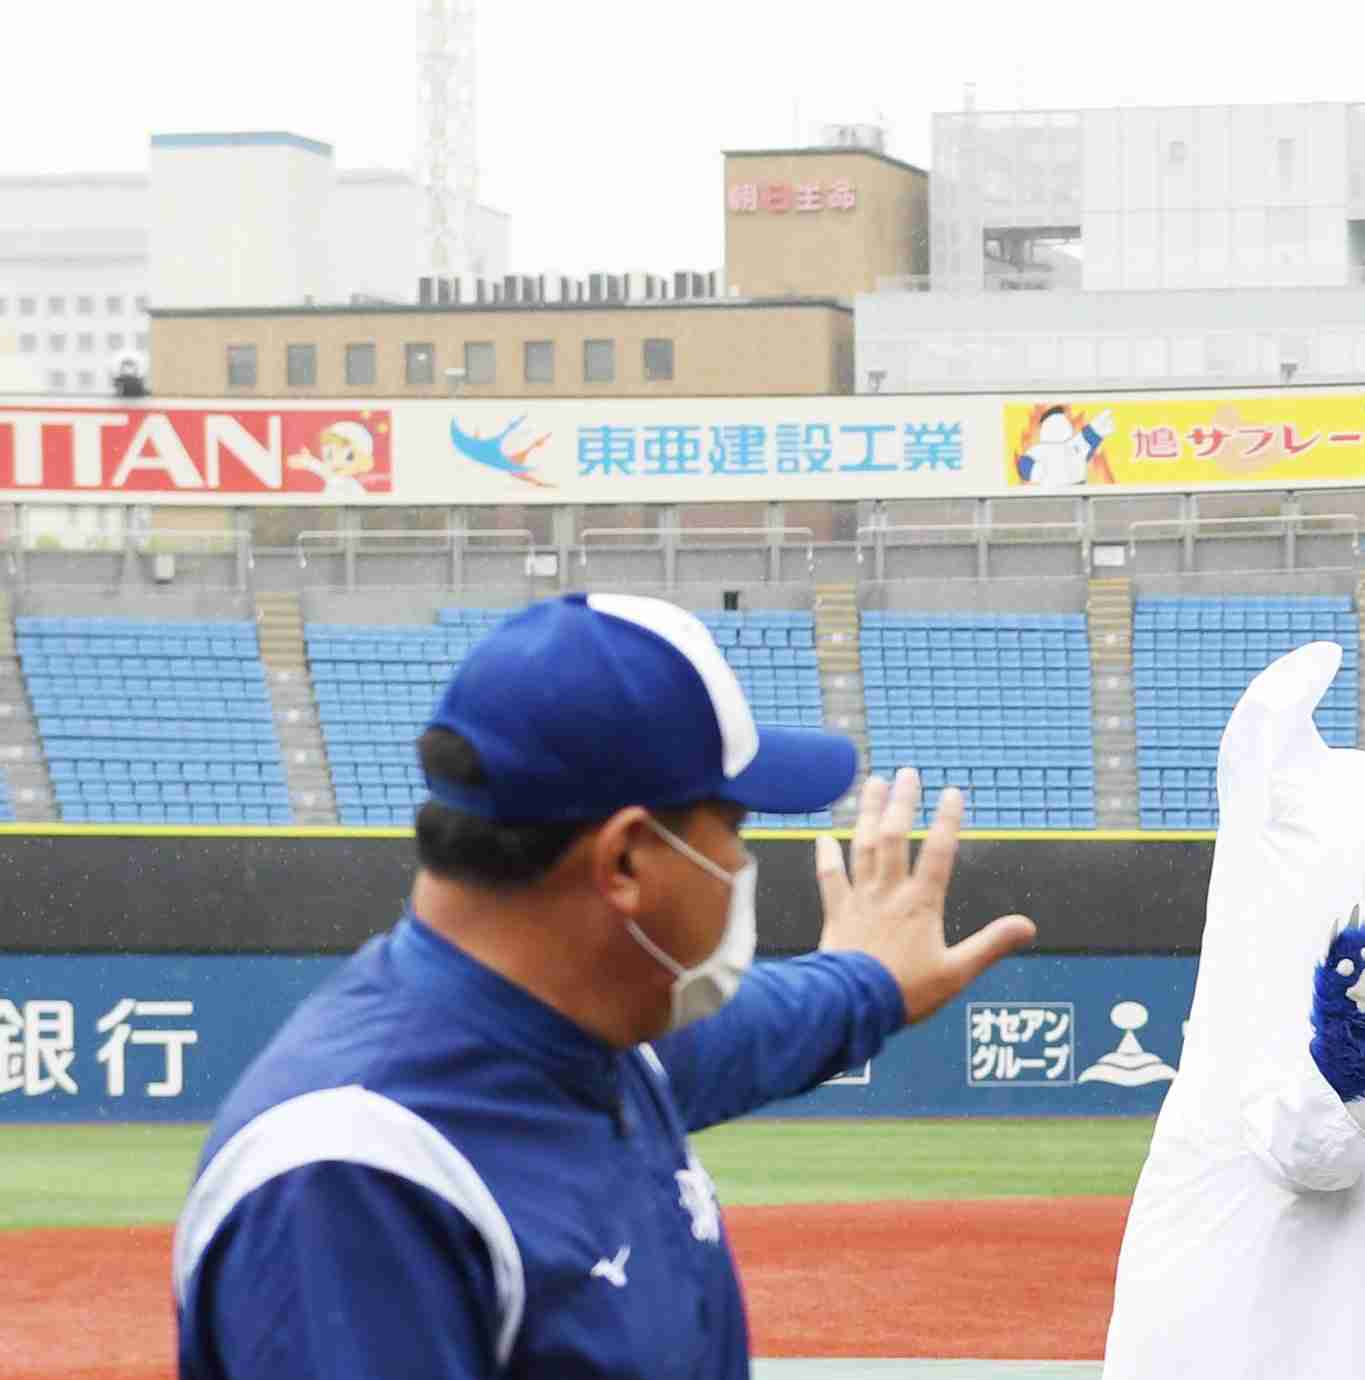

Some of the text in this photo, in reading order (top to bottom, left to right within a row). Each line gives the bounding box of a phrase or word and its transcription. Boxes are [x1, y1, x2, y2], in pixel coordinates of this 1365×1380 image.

[577, 422, 963, 476] 東亜建設工業
[971, 1008, 1070, 1043] オセアン
[971, 1045, 1070, 1080] グループ
